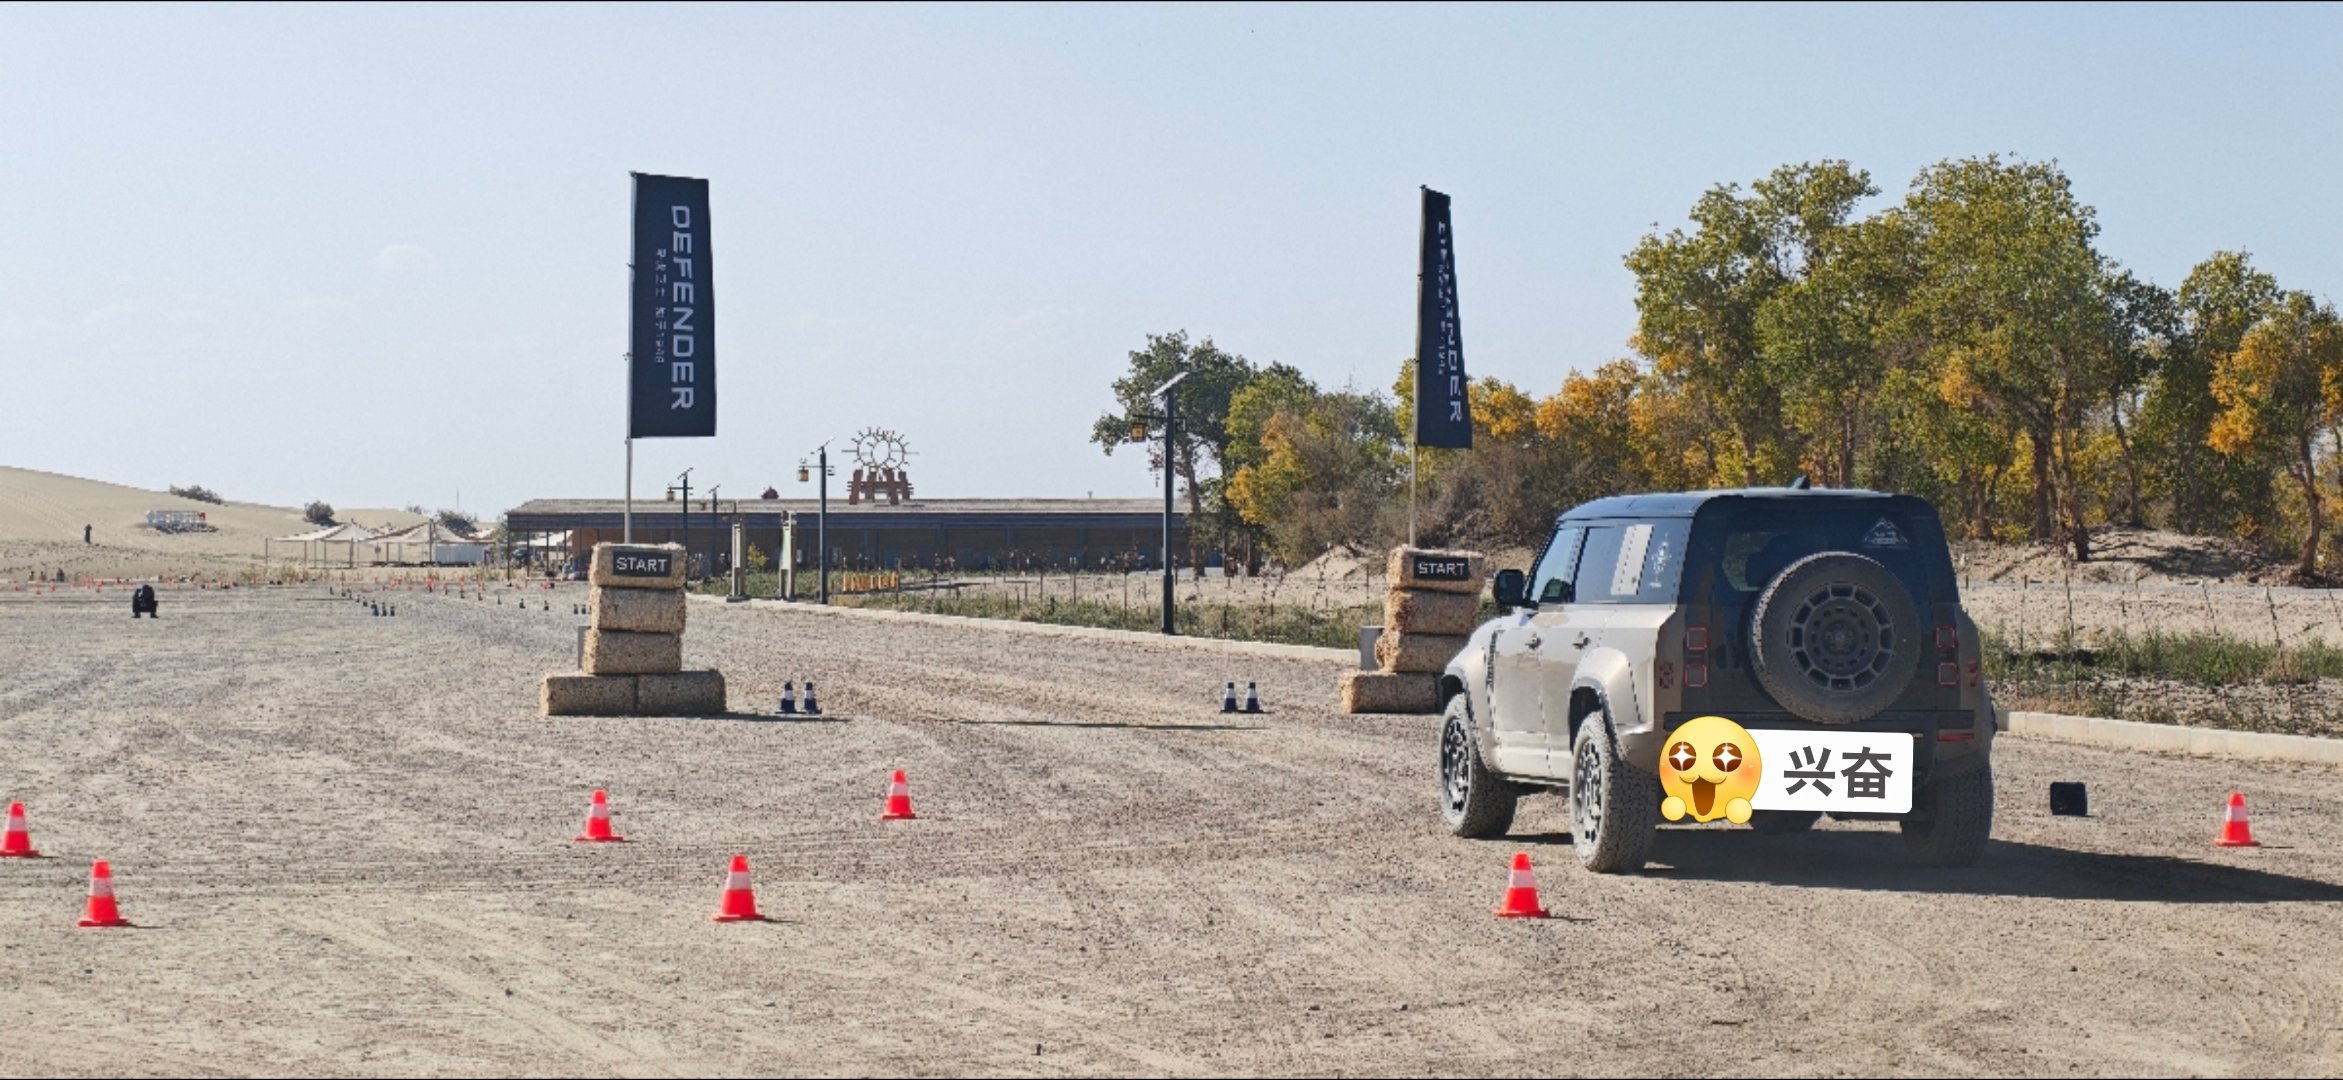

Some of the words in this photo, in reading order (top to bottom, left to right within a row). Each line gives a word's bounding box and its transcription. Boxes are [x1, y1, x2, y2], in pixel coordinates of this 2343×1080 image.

[671, 205, 694, 410] DEFENDER
[616, 556, 668, 572] START
[1418, 561, 1465, 576] START
